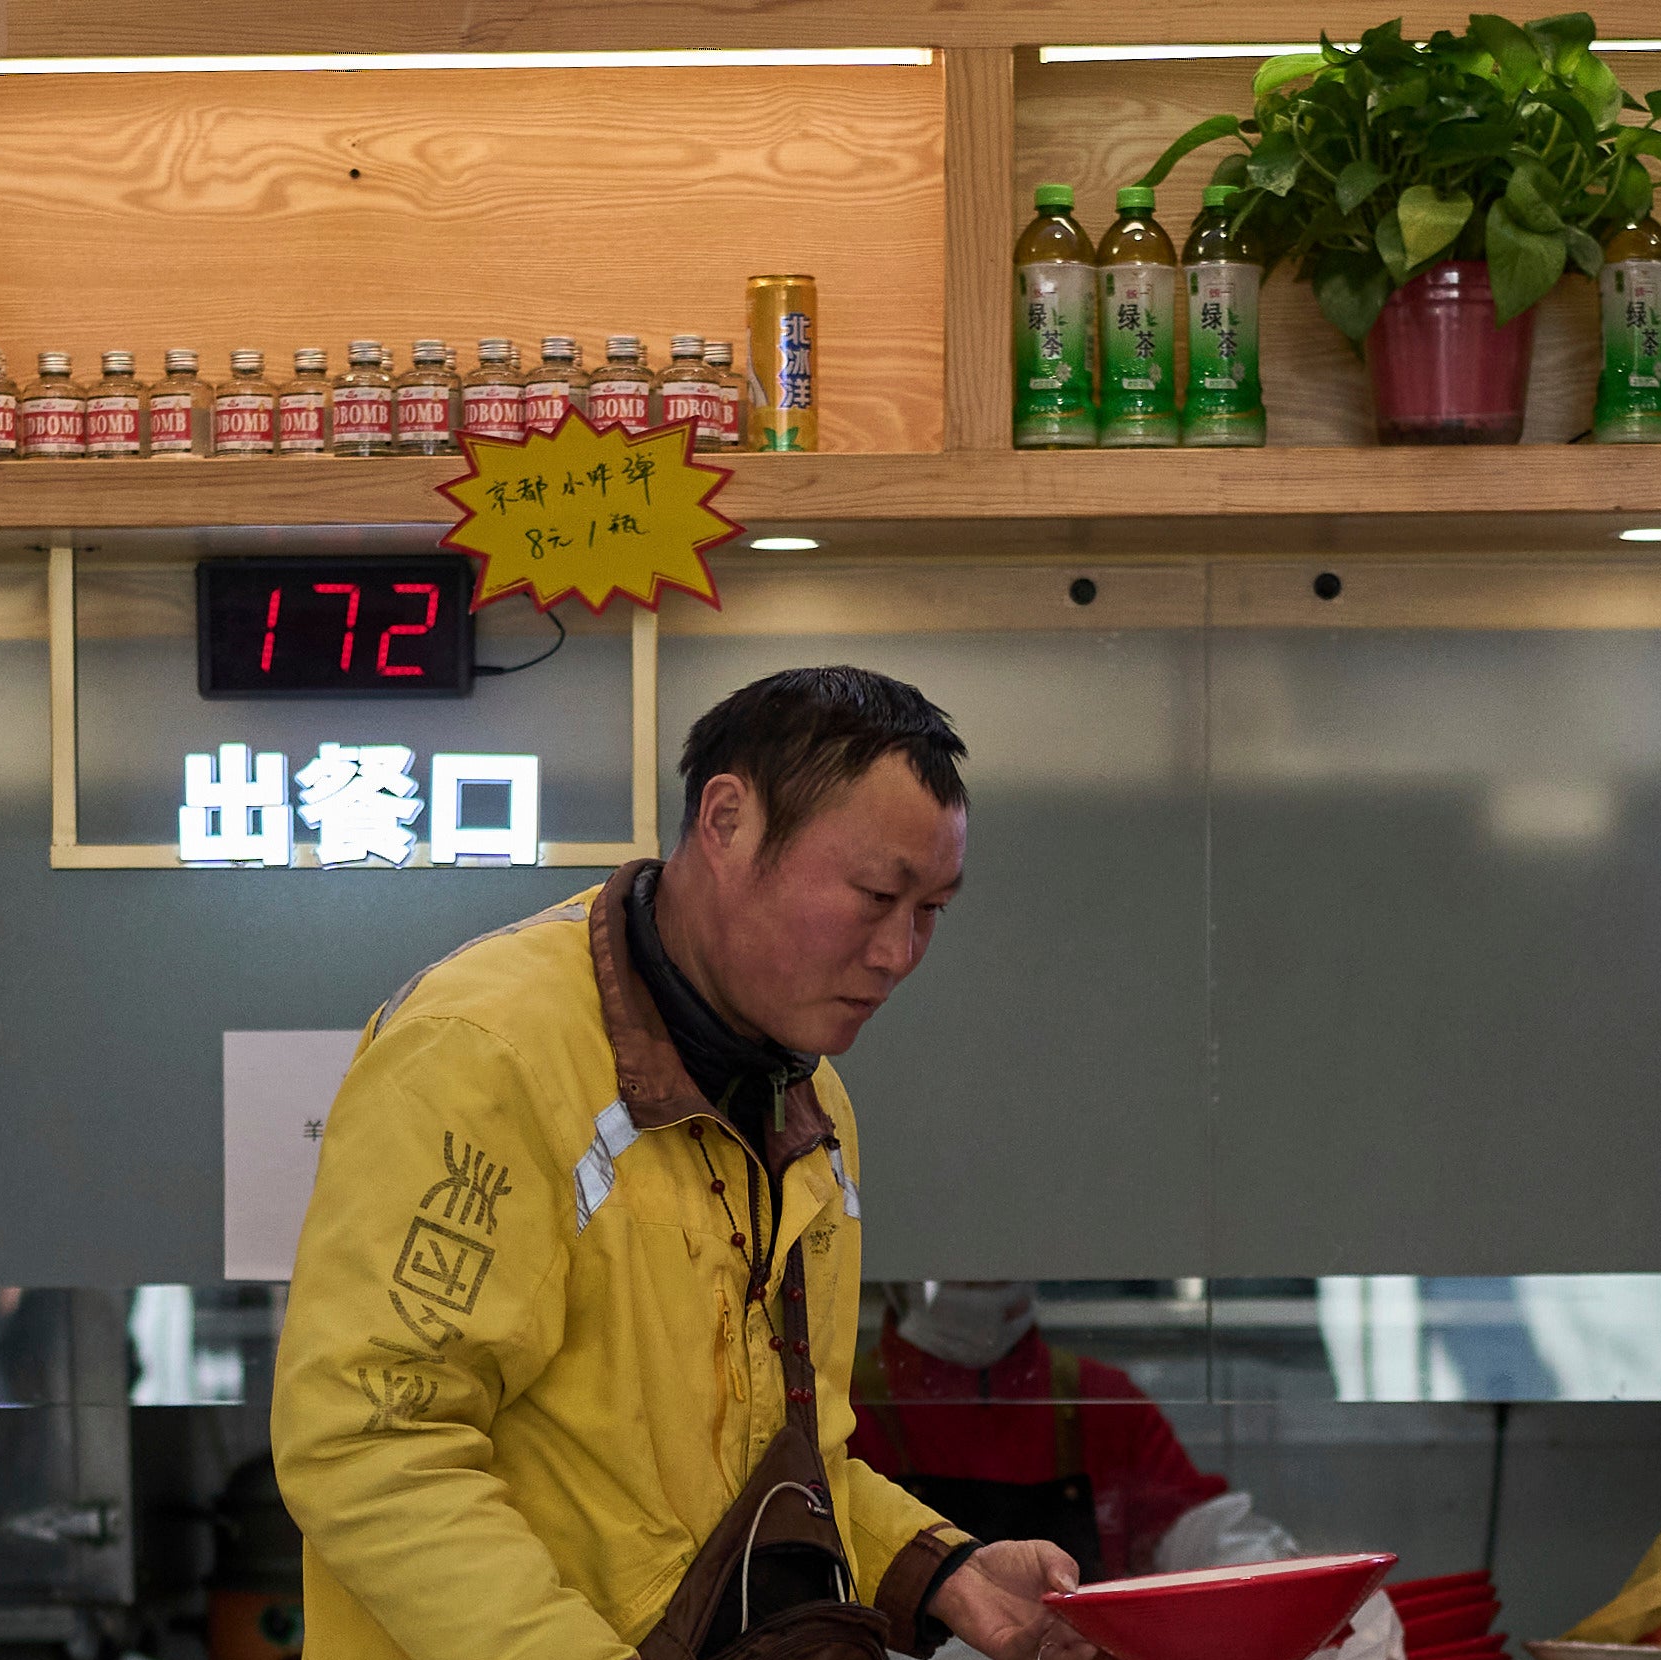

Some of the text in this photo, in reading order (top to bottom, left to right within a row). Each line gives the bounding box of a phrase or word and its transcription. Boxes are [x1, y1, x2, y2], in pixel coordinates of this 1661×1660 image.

[1028, 303, 1063, 358] 绿茶
[1117, 303, 1155, 358] 绿茶
[1201, 302, 1237, 358] 绿茶
[1626, 301, 1659, 357] 绿茶
[778, 313, 813, 409] 北冰洋
[260, 583, 439, 676] 172
[178, 742, 540, 870] 出餐口
